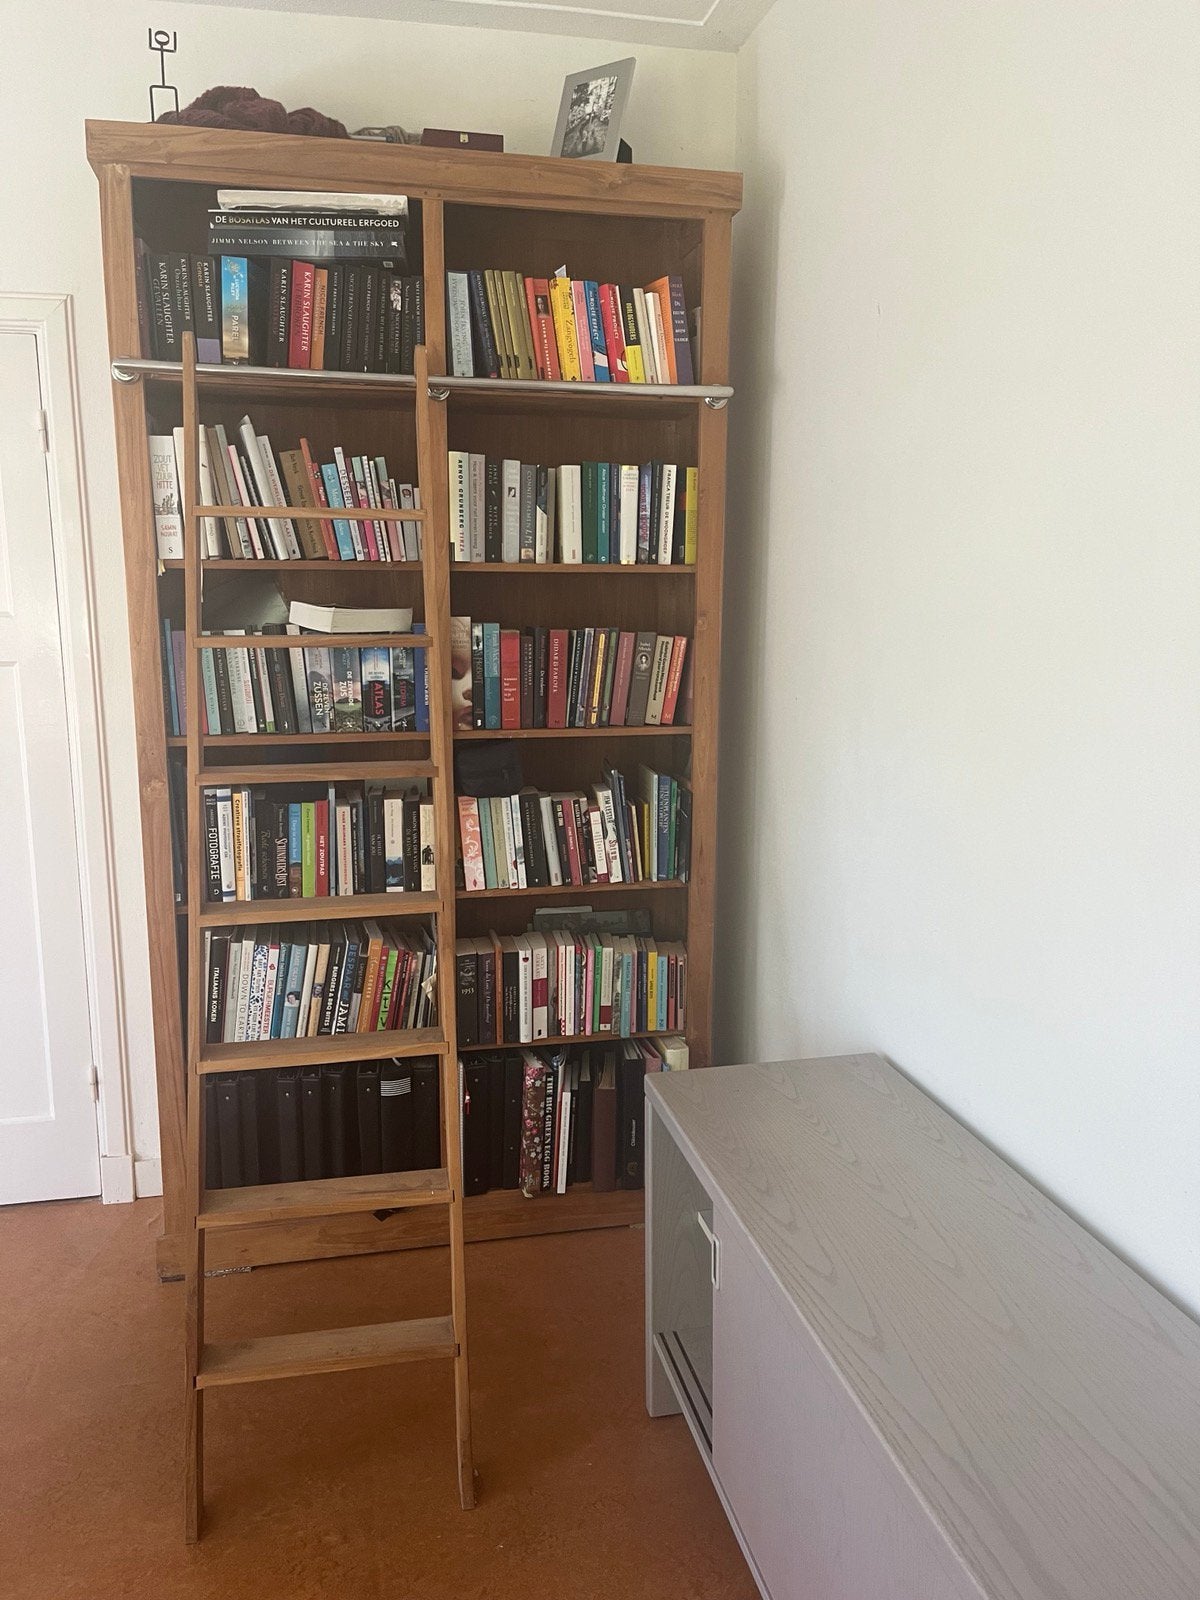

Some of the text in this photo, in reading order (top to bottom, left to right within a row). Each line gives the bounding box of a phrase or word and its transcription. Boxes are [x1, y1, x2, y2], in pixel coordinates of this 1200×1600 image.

[215, 215, 400, 228] DE BOSATLAS VAN HET CULTUREEL ERFGOED
[369, 240, 385, 248] SKY
[180, 258, 191, 321] KARIN SLAUGHTER
[196, 261, 205, 287] Genesis
[203, 262, 213, 323] KARIN SLAUGHTER
[152, 278, 164, 326] GEVALLEN
[158, 262, 175, 344] KARIN SLAUGHTER
[278, 268, 288, 343] KARIN SLAUGHTER
[301, 271, 312, 352] KARIN SLAUGHTER
[318, 284, 327, 336] NICCI FRENCH
[230, 314, 240, 342] PAREL
[564, 319, 578, 364] Zangvogels
[664, 469, 672, 493] FRANCA
[663, 511, 671, 519] DE
[662, 520, 670, 555] WOONGROEP
[663, 641, 671, 657] Gabriel
[312, 680, 325, 717] ZUSSEN
[321, 681, 332, 714] DE ZEVEN
[338, 680, 347, 698] ZUS
[346, 670, 355, 707] DE ZEVENDE
[374, 682, 386, 716] ATLAS
[399, 680, 408, 707] STORM
[234, 799, 242, 826] Creatieve
[208, 827, 221, 880] FOTOGRAFIE
[210, 967, 220, 1023] ITALIAANS KOKEN
[328, 965, 339, 993] BURGERS
[335, 943, 358, 1034] BESPAAR JAMI
[237, 973, 250, 1041] DOWN TO EARTH
[262, 979, 275, 1034] BURGERMEESTER
[323, 1011, 332, 1027] BITES
[542, 1076, 555, 1188] THE BIG GREEN EGG BOOK
